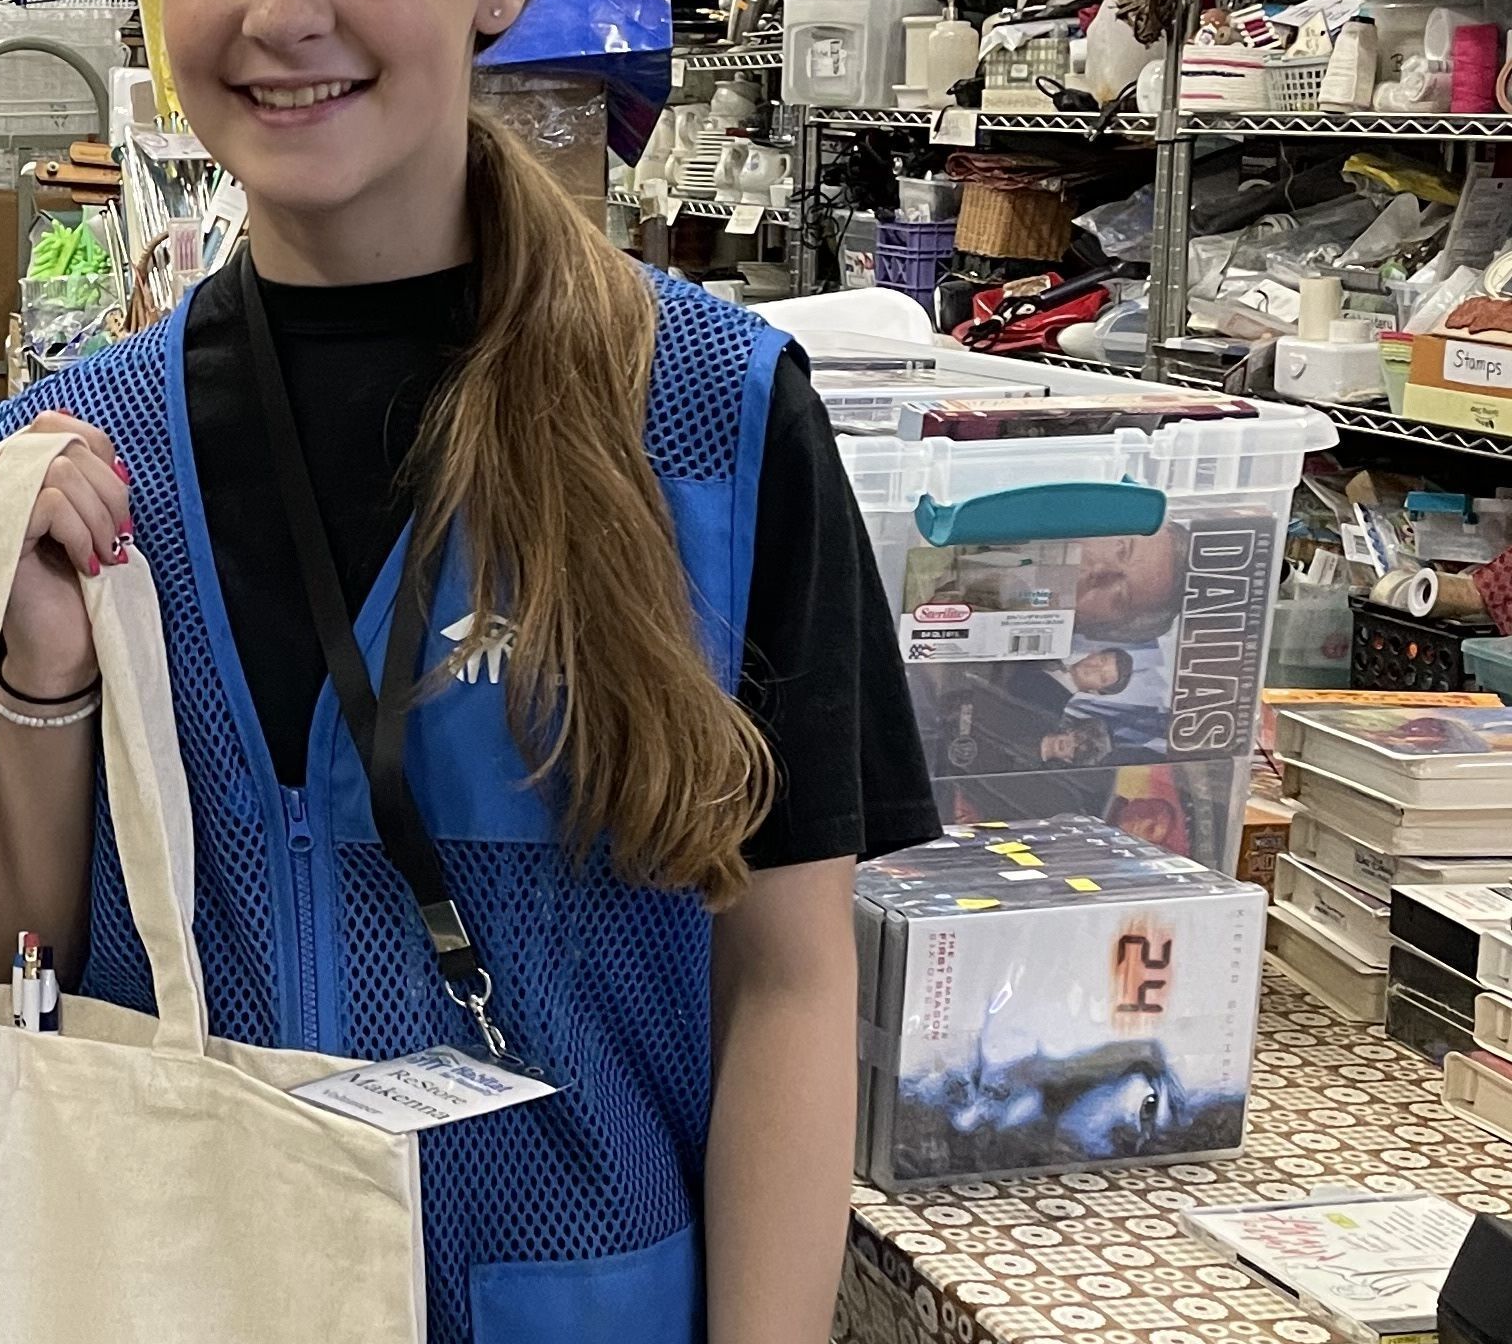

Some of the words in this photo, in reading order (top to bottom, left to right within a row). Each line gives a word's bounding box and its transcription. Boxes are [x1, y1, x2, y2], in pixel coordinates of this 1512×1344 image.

[1453, 350, 1502, 381] Stamps
[1169, 529, 1256, 752] DALLAS
[936, 932, 946, 974] FIRST
[947, 932, 955, 958] THE
[1116, 934, 1172, 1013] 24
[932, 981, 943, 1041] SEASON
[343, 1072, 450, 1120] Makenna
